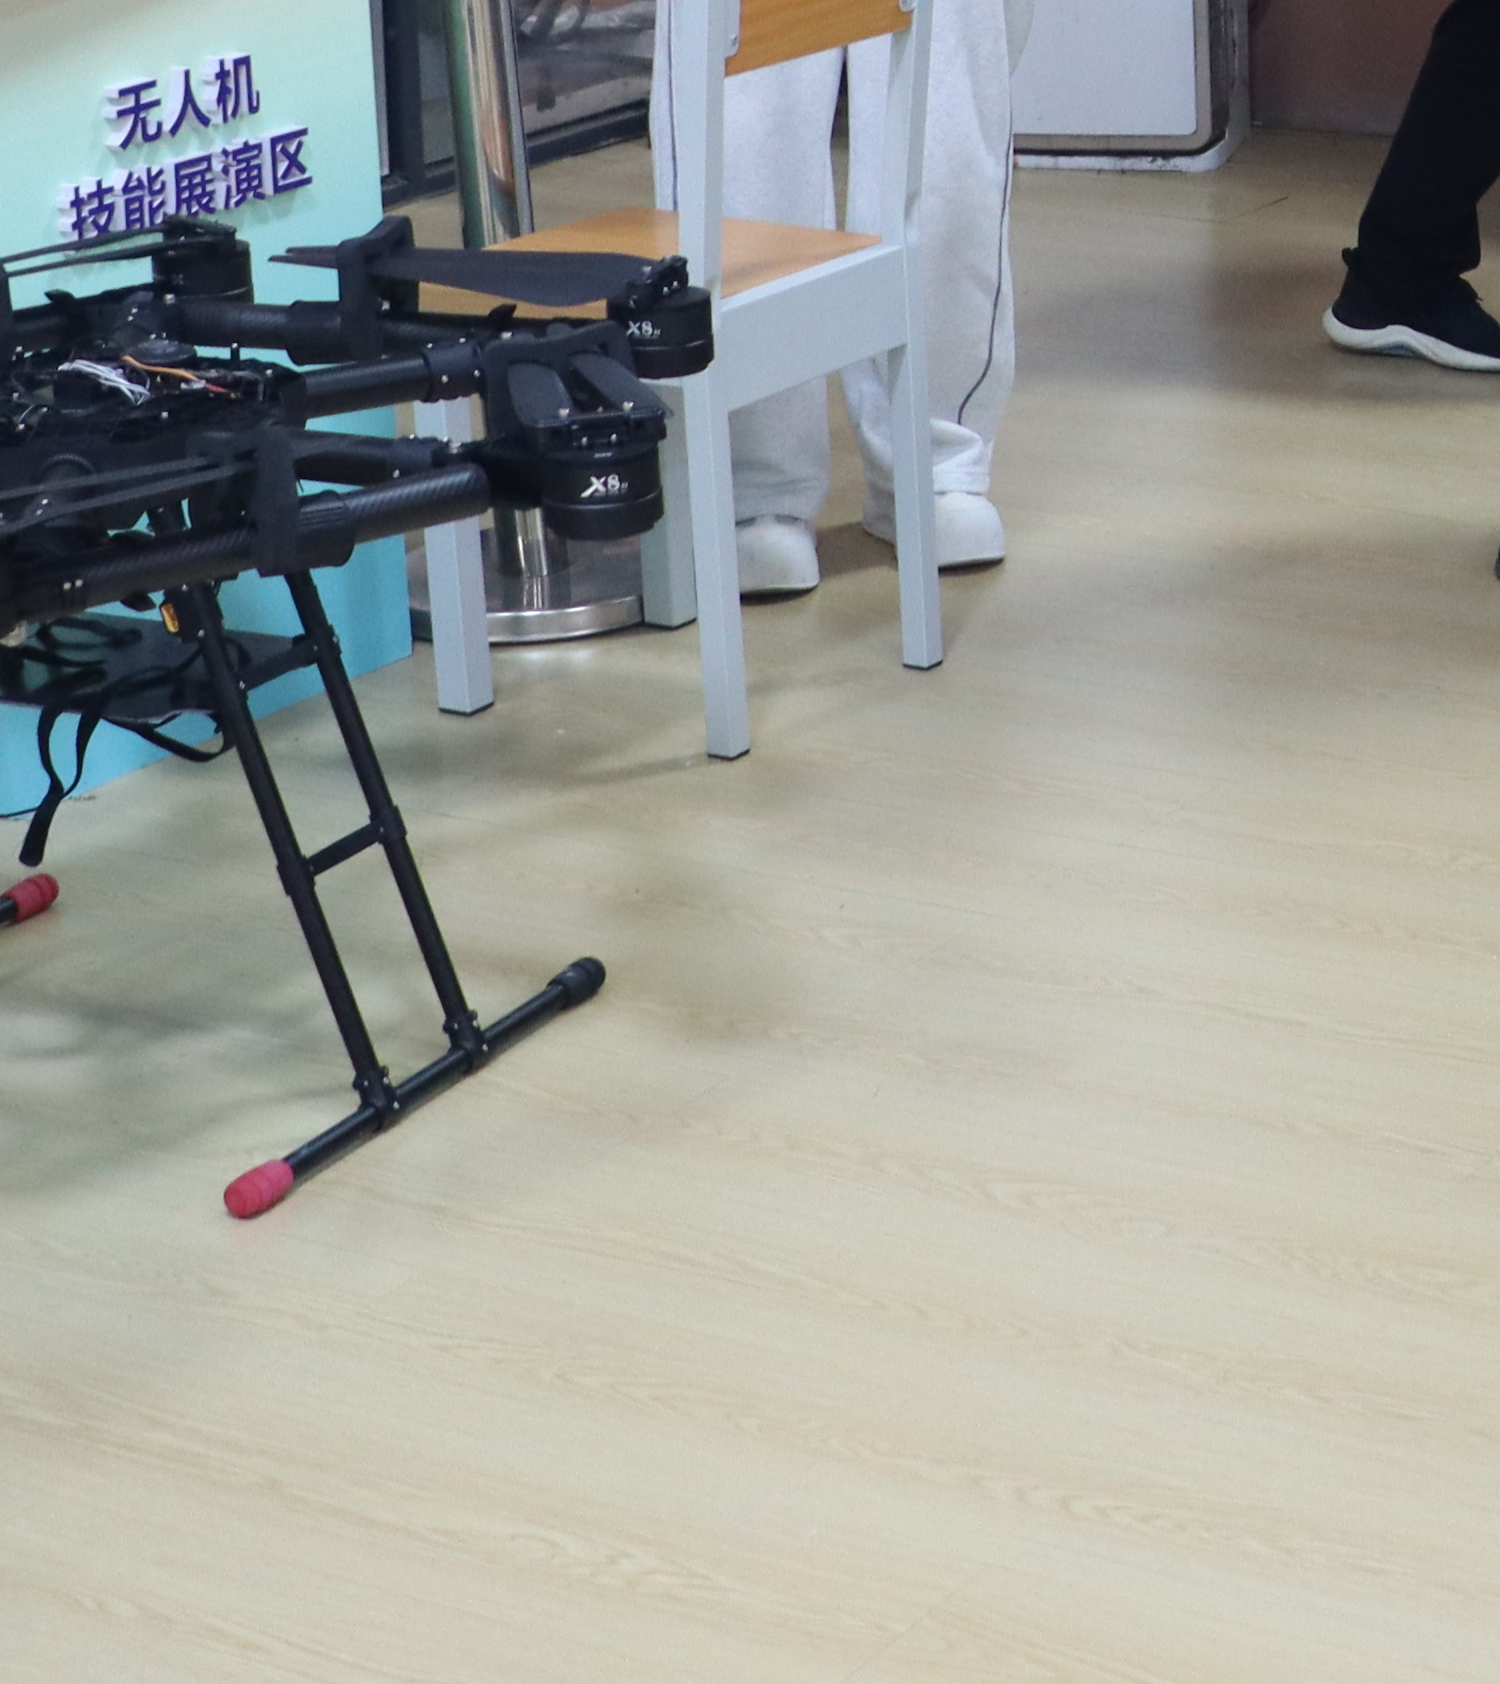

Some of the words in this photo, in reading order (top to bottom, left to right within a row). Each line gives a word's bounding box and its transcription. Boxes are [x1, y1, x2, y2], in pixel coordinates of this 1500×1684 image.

[111, 55, 260, 150] 无人机
[64, 127, 312, 240] 技能展演区
